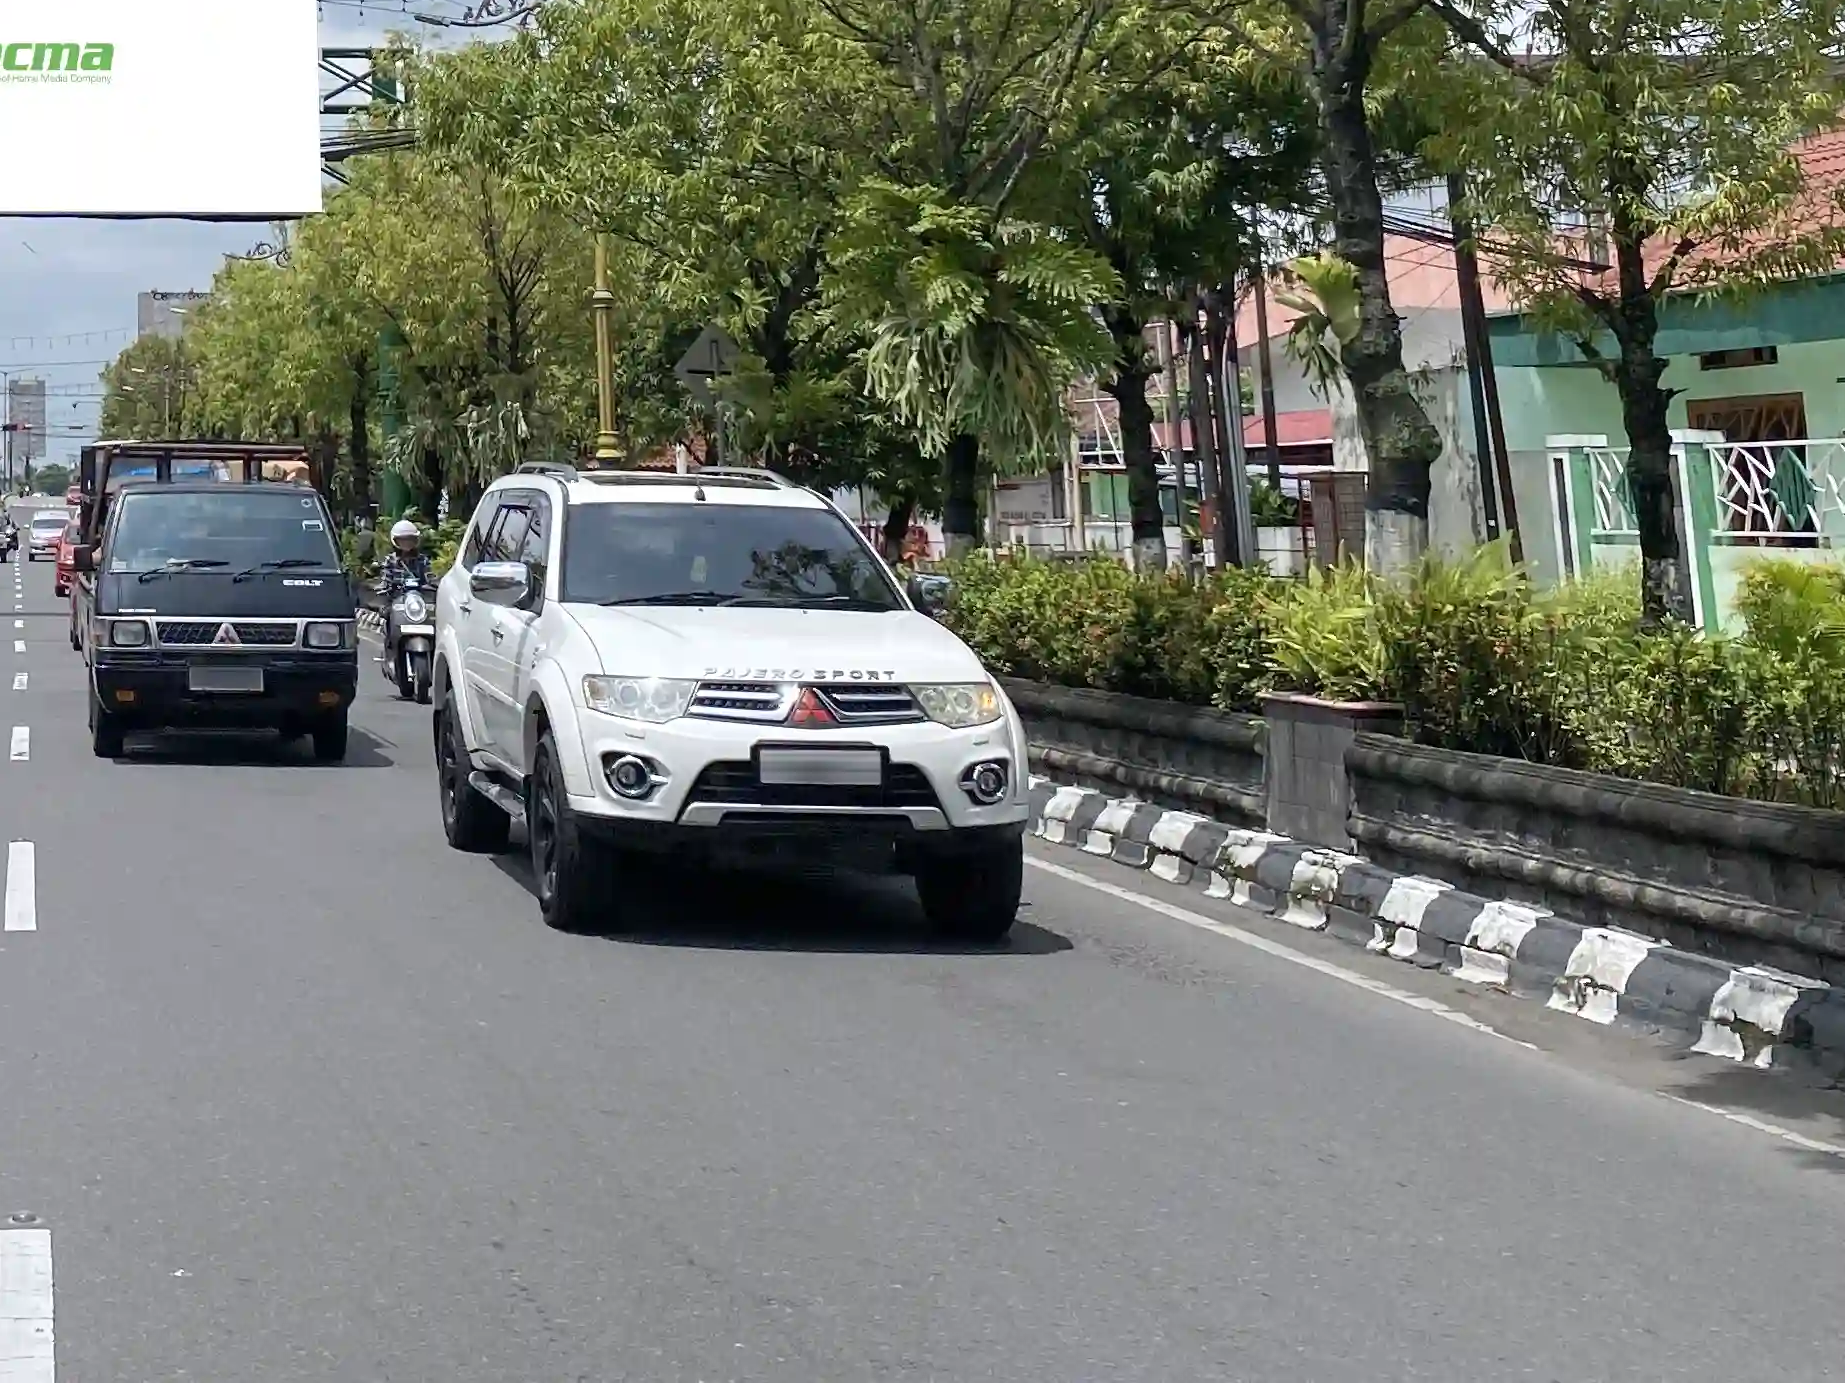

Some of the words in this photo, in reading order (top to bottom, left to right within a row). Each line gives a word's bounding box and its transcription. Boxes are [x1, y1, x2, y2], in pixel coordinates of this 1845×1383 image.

[40, 73, 68, 83] Media
[70, 73, 112, 85] Company
[704, 668, 806, 679] PAJERO
[813, 670, 895, 680] SPORT
